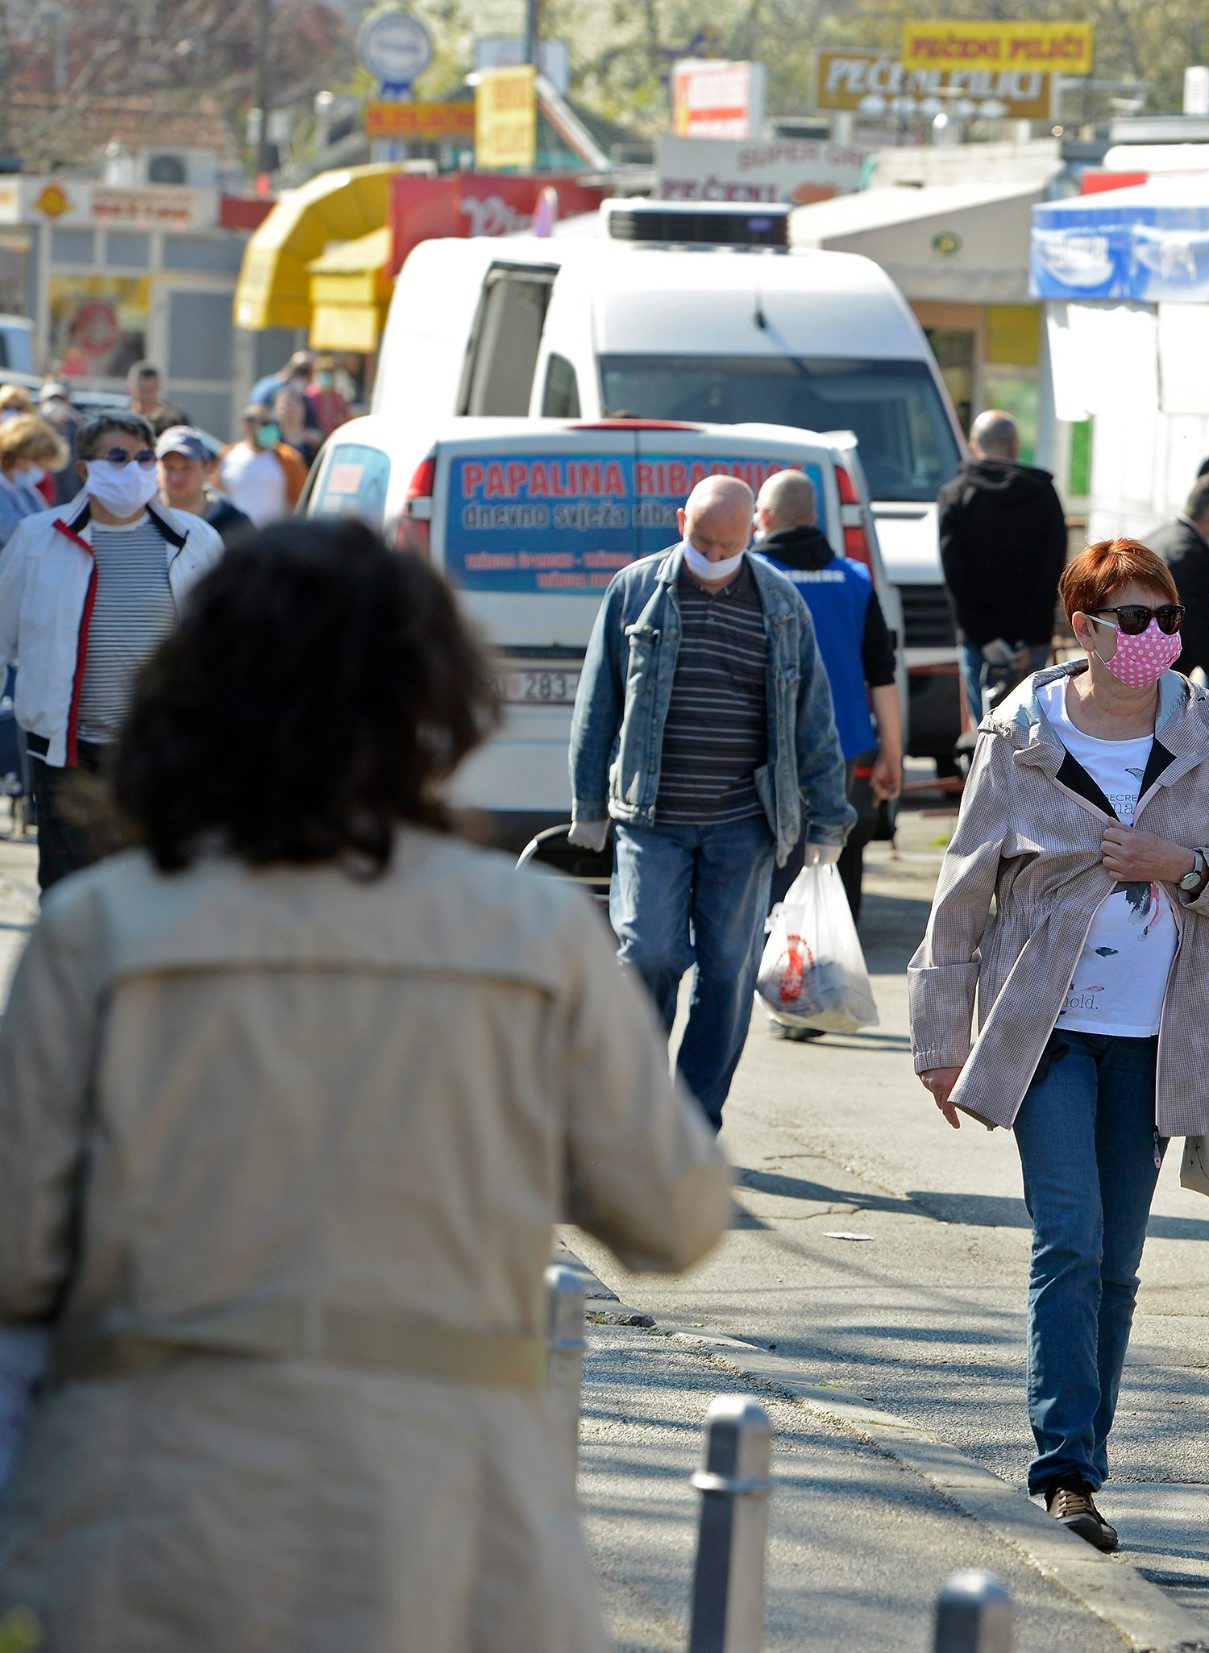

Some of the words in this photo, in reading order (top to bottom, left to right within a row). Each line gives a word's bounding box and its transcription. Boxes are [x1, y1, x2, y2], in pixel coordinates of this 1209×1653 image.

[462, 462, 625, 497] PAPALINA
[463, 503, 549, 529] dnevno
[553, 503, 628, 531] svježa
